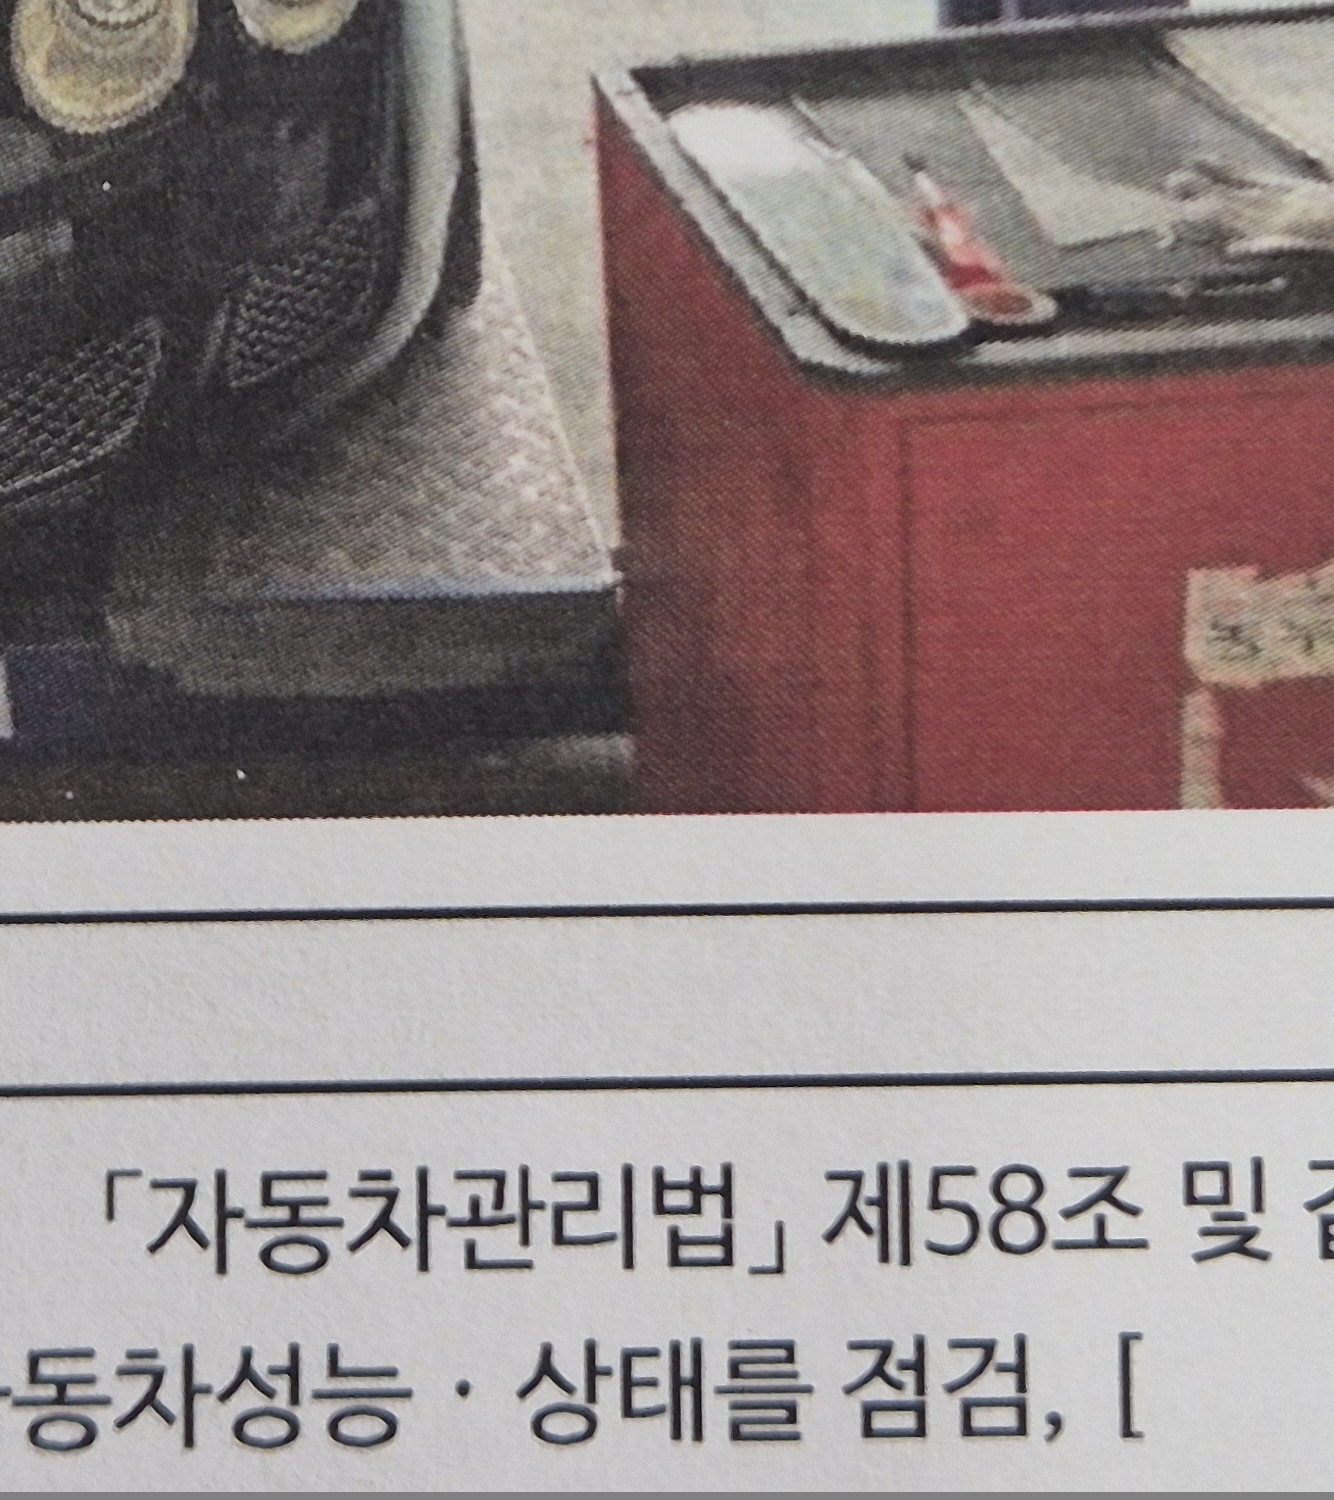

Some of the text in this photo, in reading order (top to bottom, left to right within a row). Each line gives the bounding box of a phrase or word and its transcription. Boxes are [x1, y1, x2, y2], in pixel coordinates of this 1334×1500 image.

[104, 1161, 787, 1277] 「자동차관리법」
[821, 1158, 1151, 1268] 제58조
[1183, 1156, 1273, 1264] 및
[516, 1337, 815, 1447] 상태를
[842, 1333, 1064, 1443] 점검,
